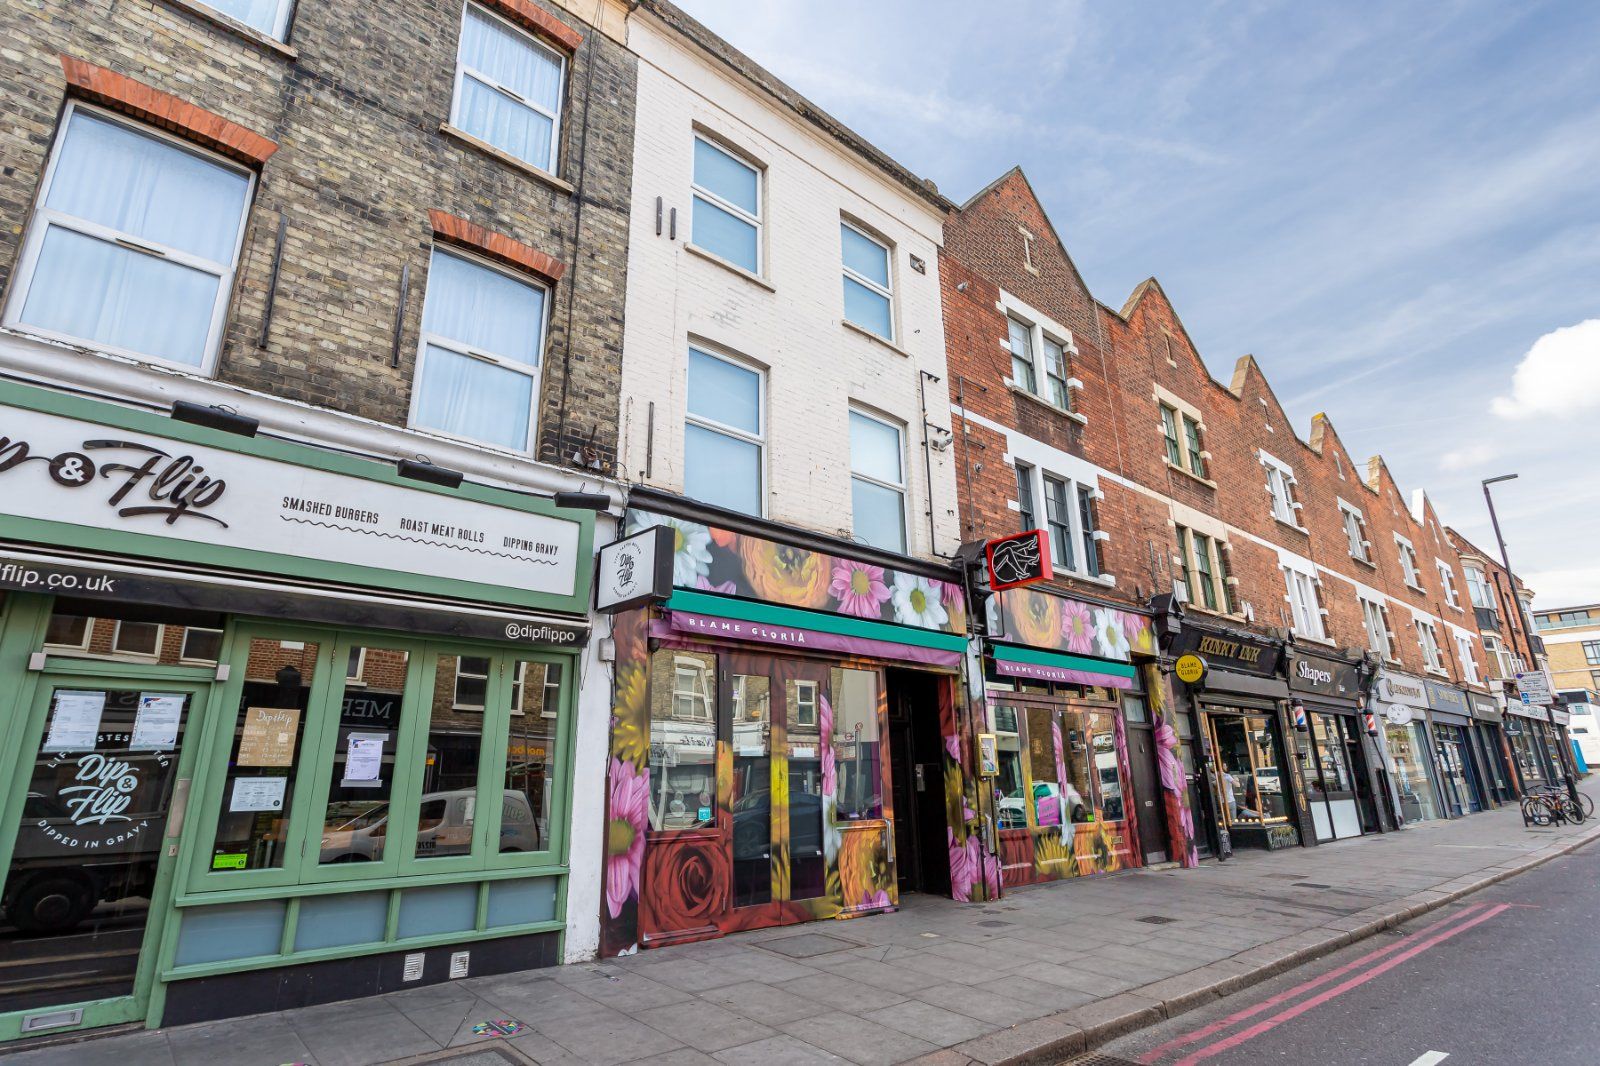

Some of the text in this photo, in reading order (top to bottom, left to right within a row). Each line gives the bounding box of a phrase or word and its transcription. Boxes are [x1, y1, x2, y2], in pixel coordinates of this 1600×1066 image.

[82, 439, 229, 529] Flip
[282, 496, 559, 556] SMASHED BURGERS ROAST MEAT ROLLS DIPPING GRAVY
[0, 563, 115, 593] flip.co.uk
[505, 623, 576, 643] @dipflippo
[689, 618, 805, 643] BLAME GLORIA
[1004, 665, 1066, 679] BLAME GLORIA
[1299, 661, 1331, 686] Shapers
[75, 753, 140, 788] Dip
[58, 786, 133, 826] Flip
[37, 819, 149, 848] DIPPED IN GRAVY
